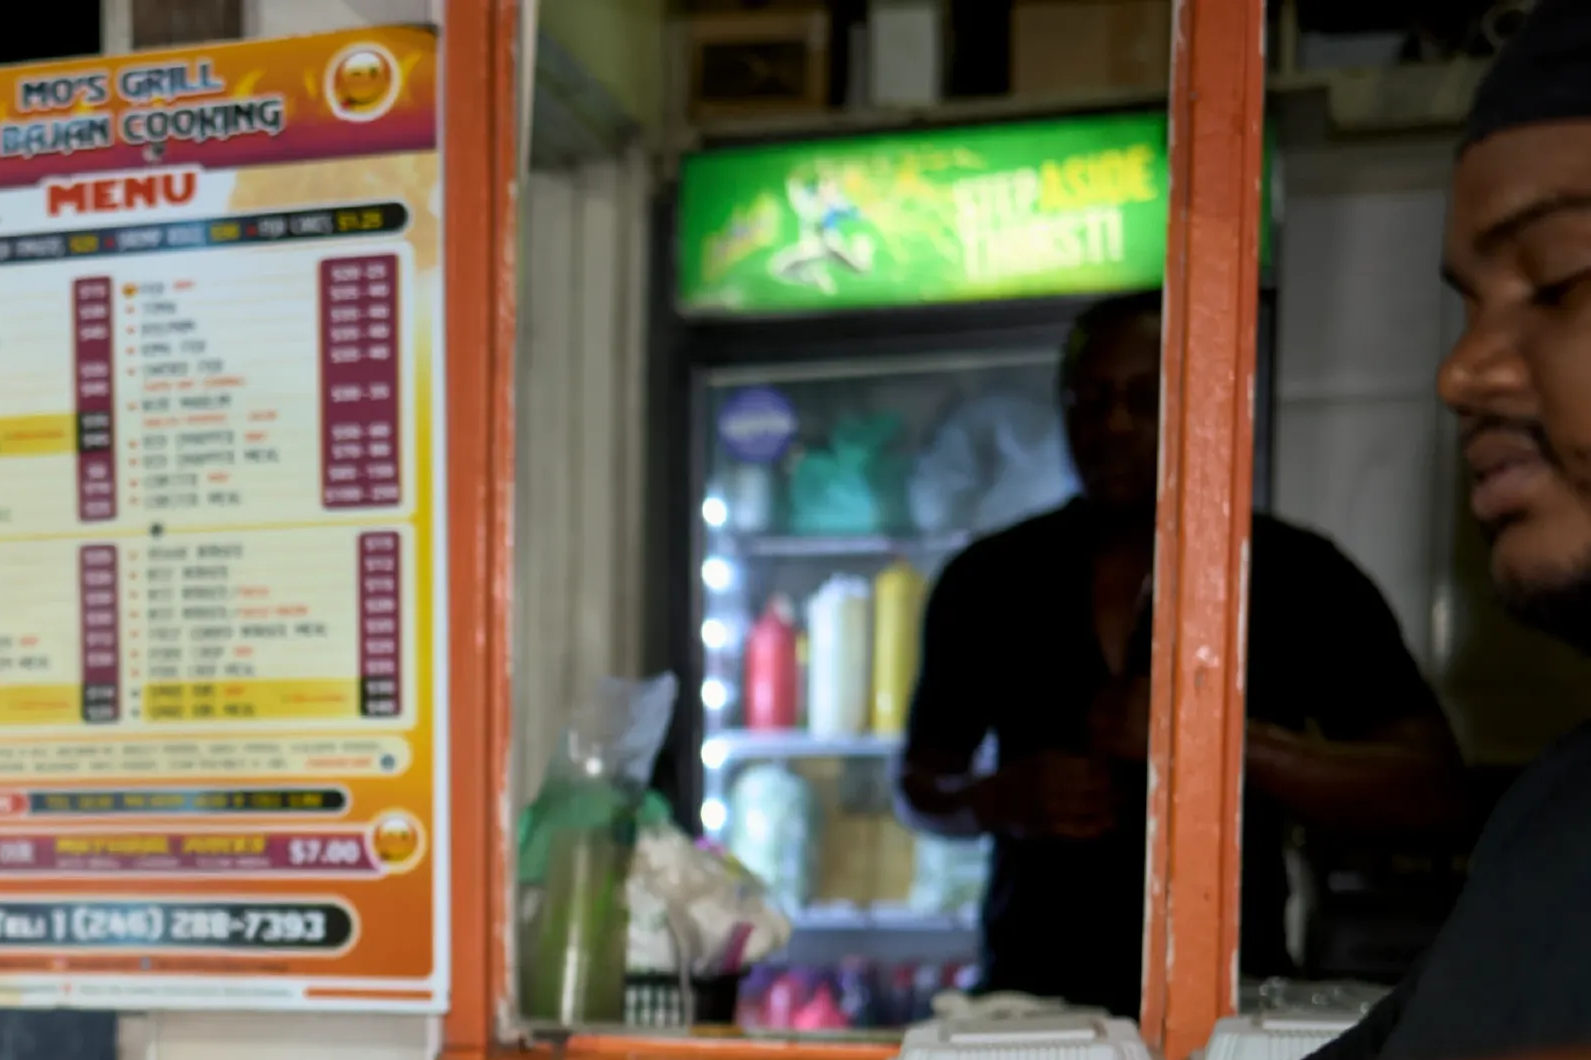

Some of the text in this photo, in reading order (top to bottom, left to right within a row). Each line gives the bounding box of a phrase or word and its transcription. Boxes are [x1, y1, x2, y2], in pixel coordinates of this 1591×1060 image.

[20, 61, 224, 111] MO'S GRILL
[122, 98, 283, 143] COOKING
[47, 172, 195, 216] MENU
